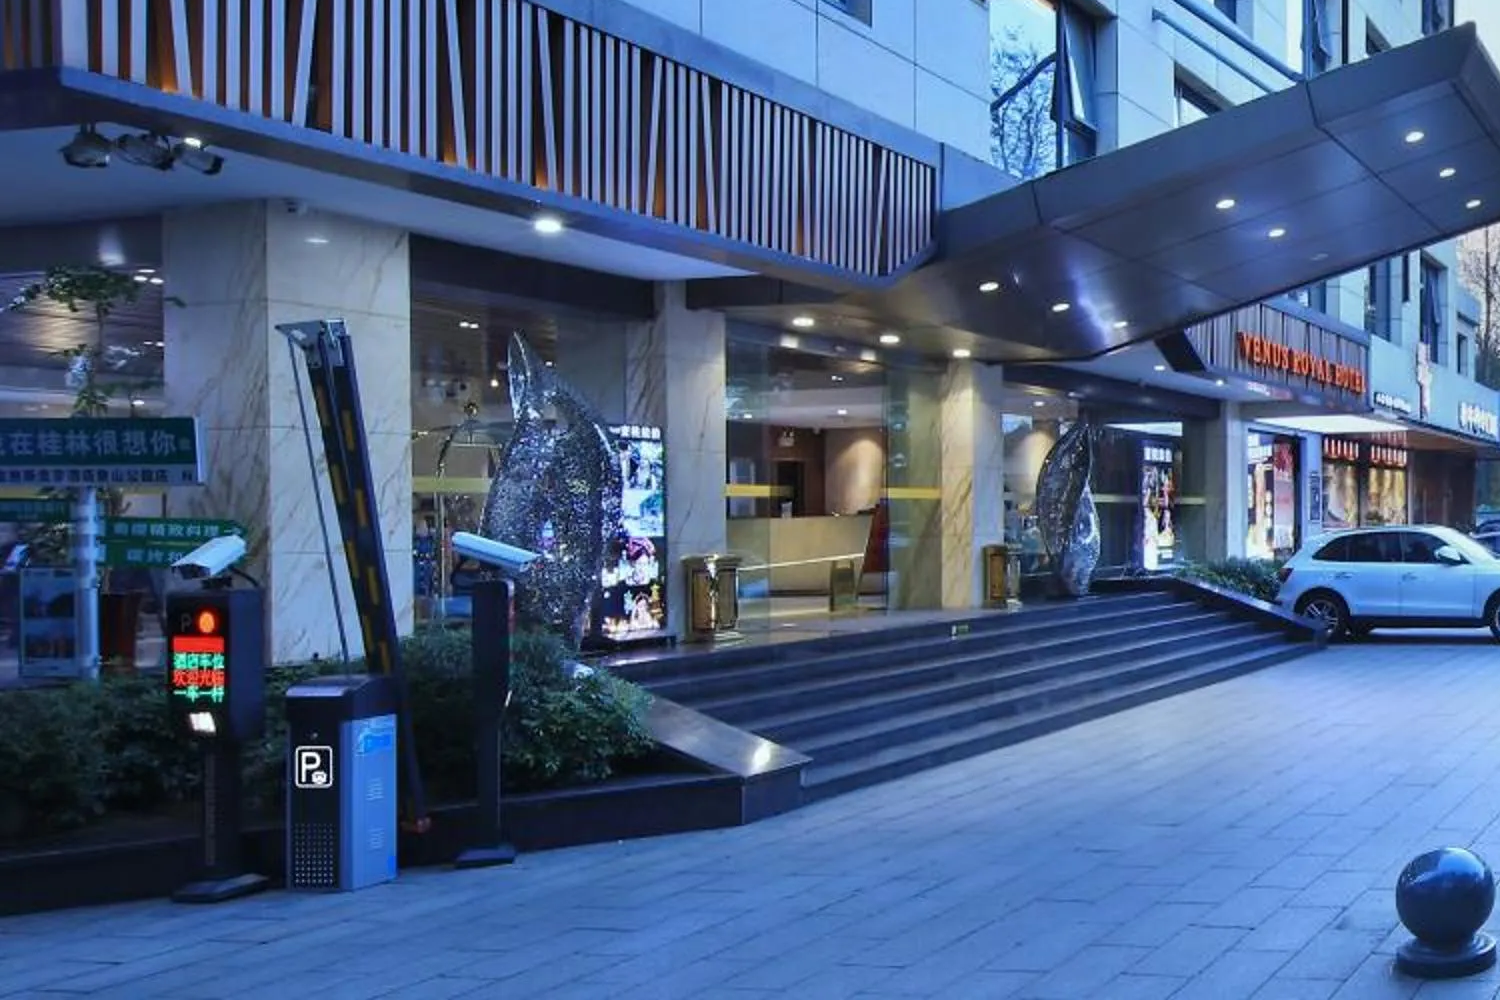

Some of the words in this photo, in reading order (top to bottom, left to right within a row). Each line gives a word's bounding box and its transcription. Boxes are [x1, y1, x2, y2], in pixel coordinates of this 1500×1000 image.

[1236, 331, 1290, 369] VENUS
[1293, 349, 1332, 385] ROYAL
[1334, 363, 1367, 395] HOTEL
[0, 429, 178, 457] 在桂林很想你
[173, 669, 225, 686] 欢迎光临
[301, 751, 321, 783] P
